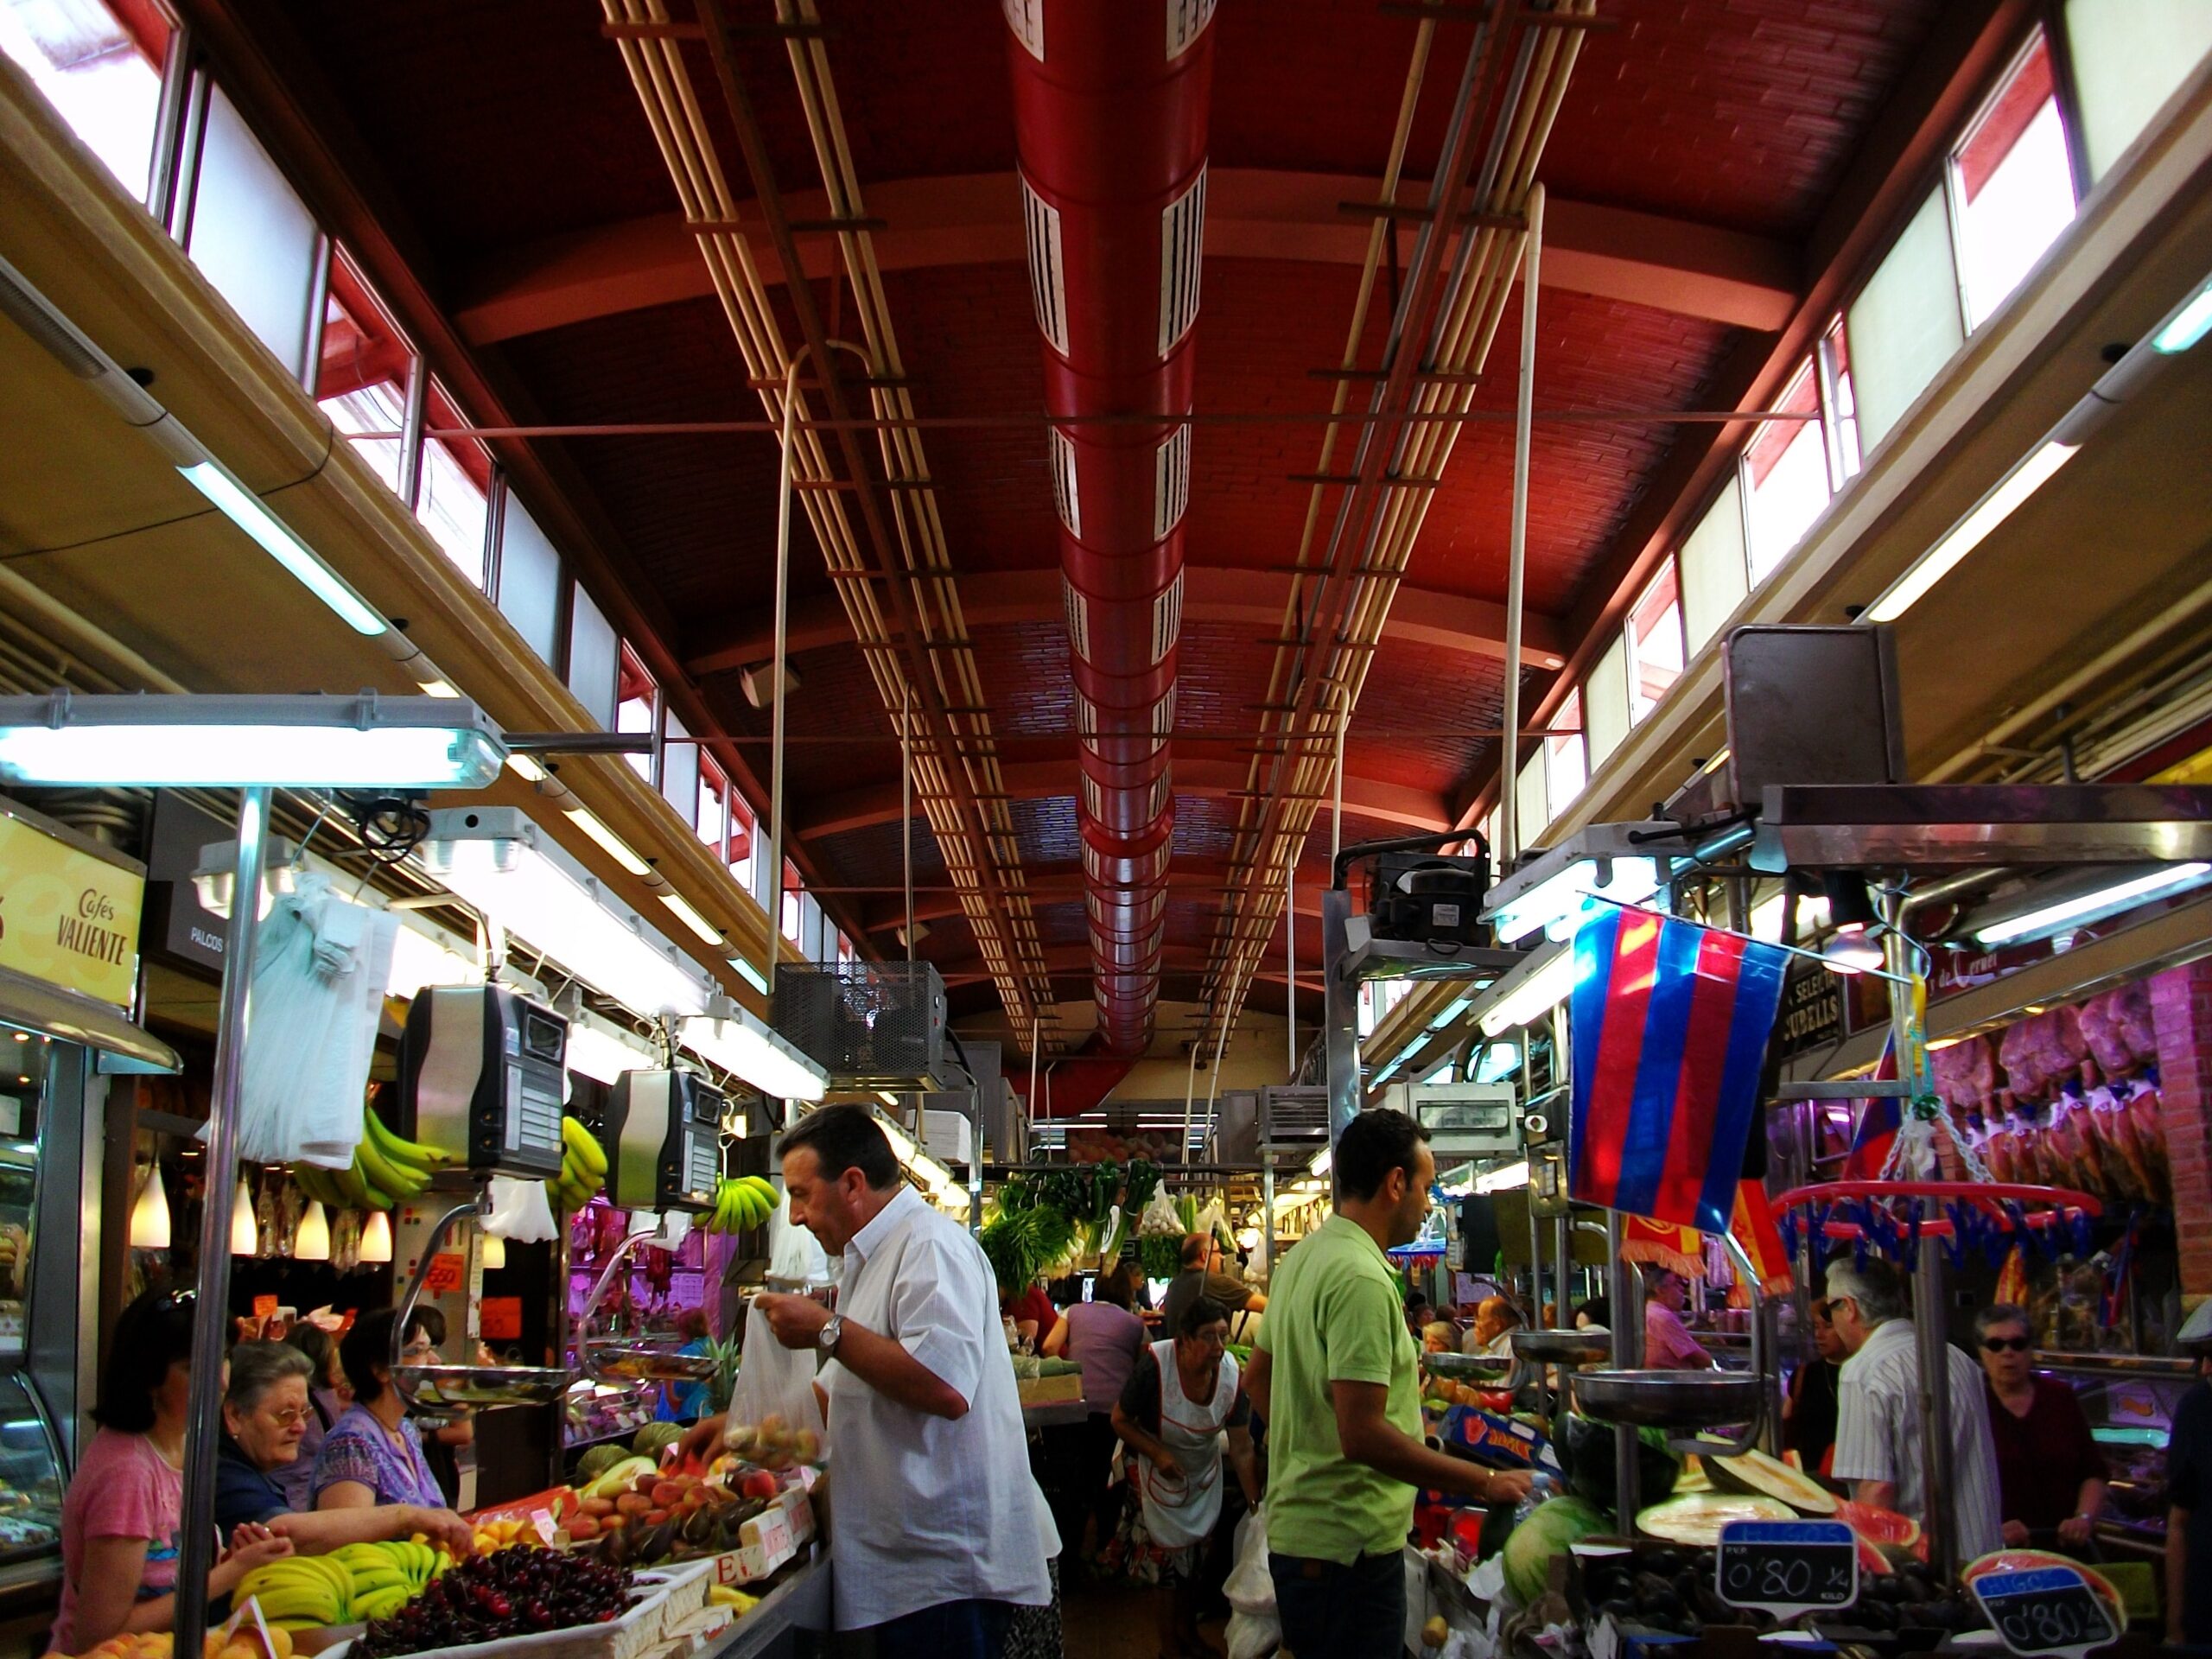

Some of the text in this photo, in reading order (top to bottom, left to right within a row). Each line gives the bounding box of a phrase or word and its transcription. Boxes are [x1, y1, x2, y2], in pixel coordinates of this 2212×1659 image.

[79, 888, 115, 921] Cafés
[57, 914, 128, 965] VALIENTE
[191, 926, 224, 952] PALCOS
